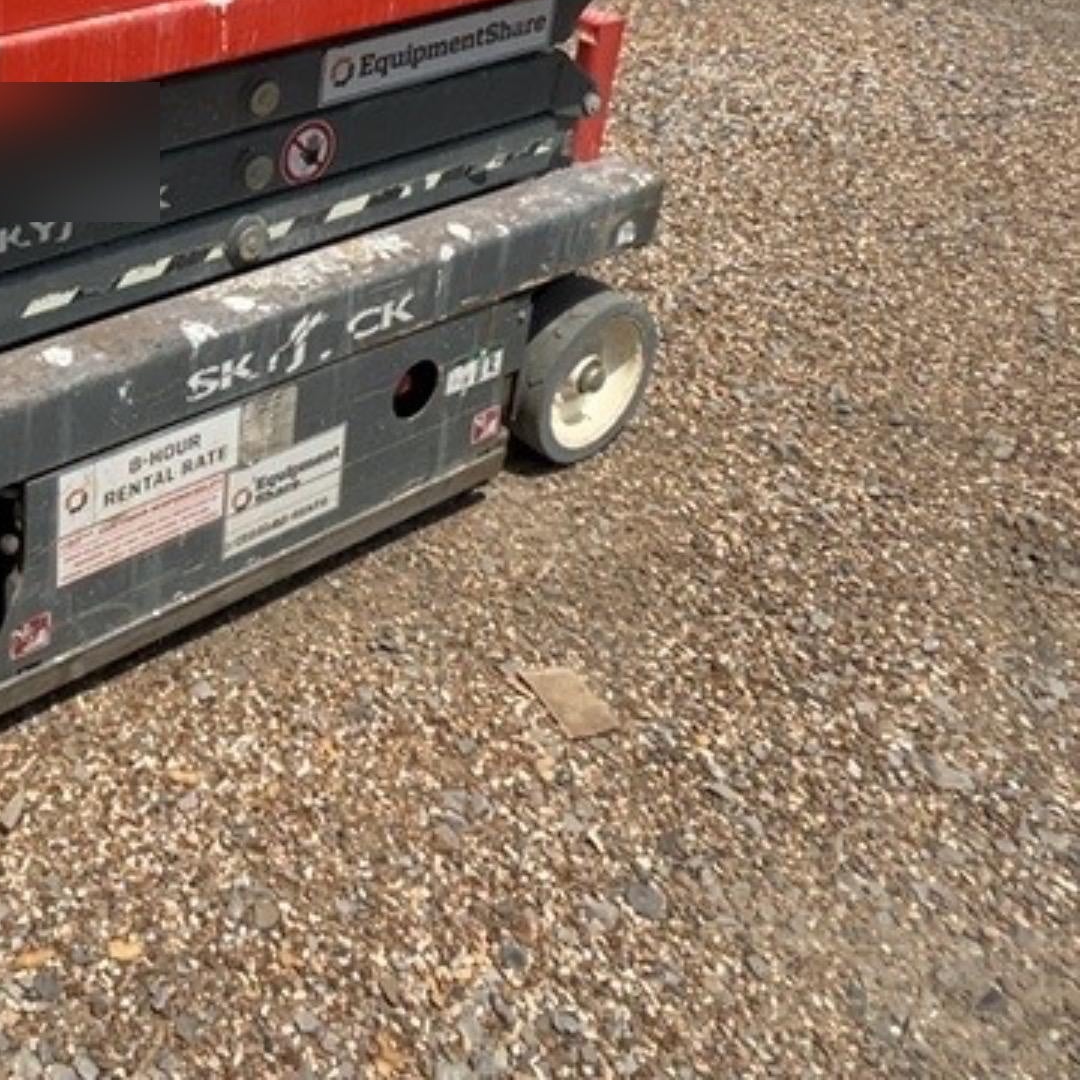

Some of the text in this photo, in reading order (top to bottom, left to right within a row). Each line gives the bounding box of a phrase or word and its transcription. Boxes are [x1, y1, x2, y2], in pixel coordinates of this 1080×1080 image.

[358, 14, 548, 79] EquipmentShare
[103, 445, 228, 508] RENTAL RATE
